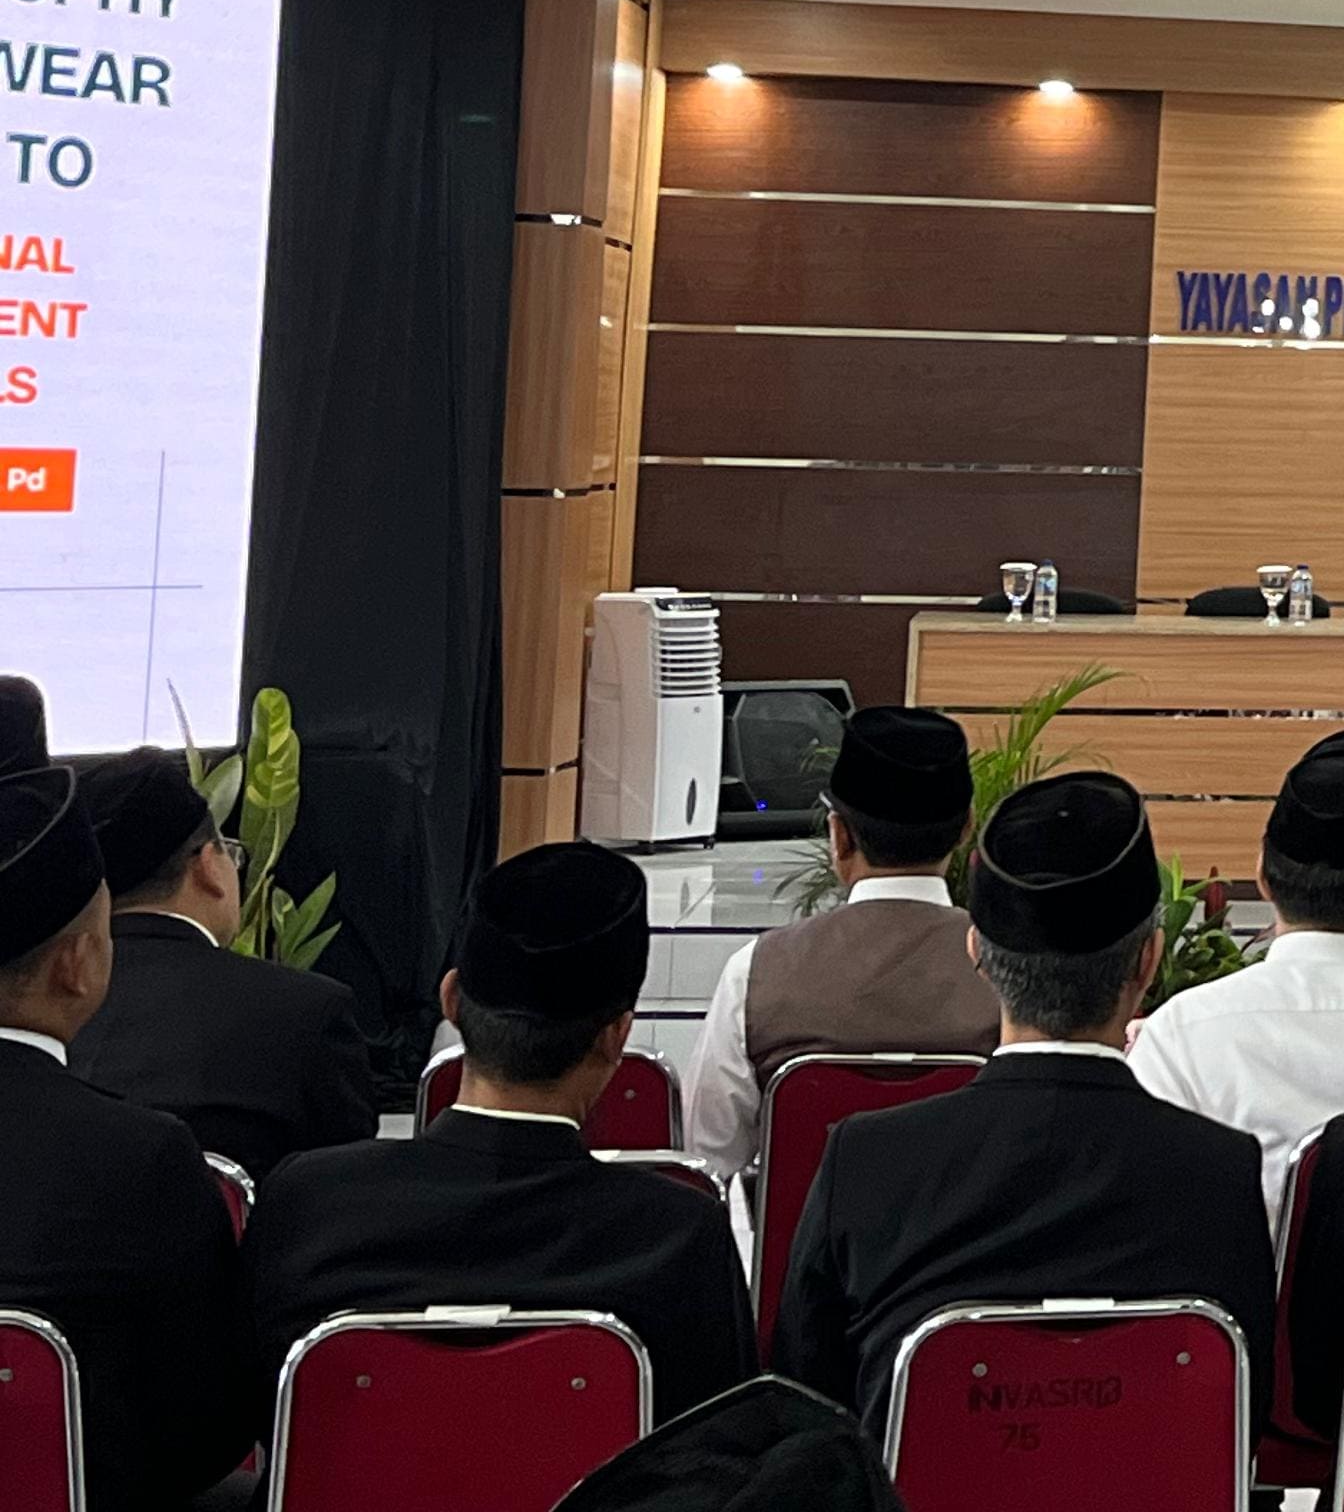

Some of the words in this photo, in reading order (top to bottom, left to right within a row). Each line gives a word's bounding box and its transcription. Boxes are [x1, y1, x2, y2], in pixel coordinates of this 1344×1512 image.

[7, 132, 92, 187] TO
[1177, 271, 1321, 339] YAYASAN
[8, 467, 46, 492] Pd
